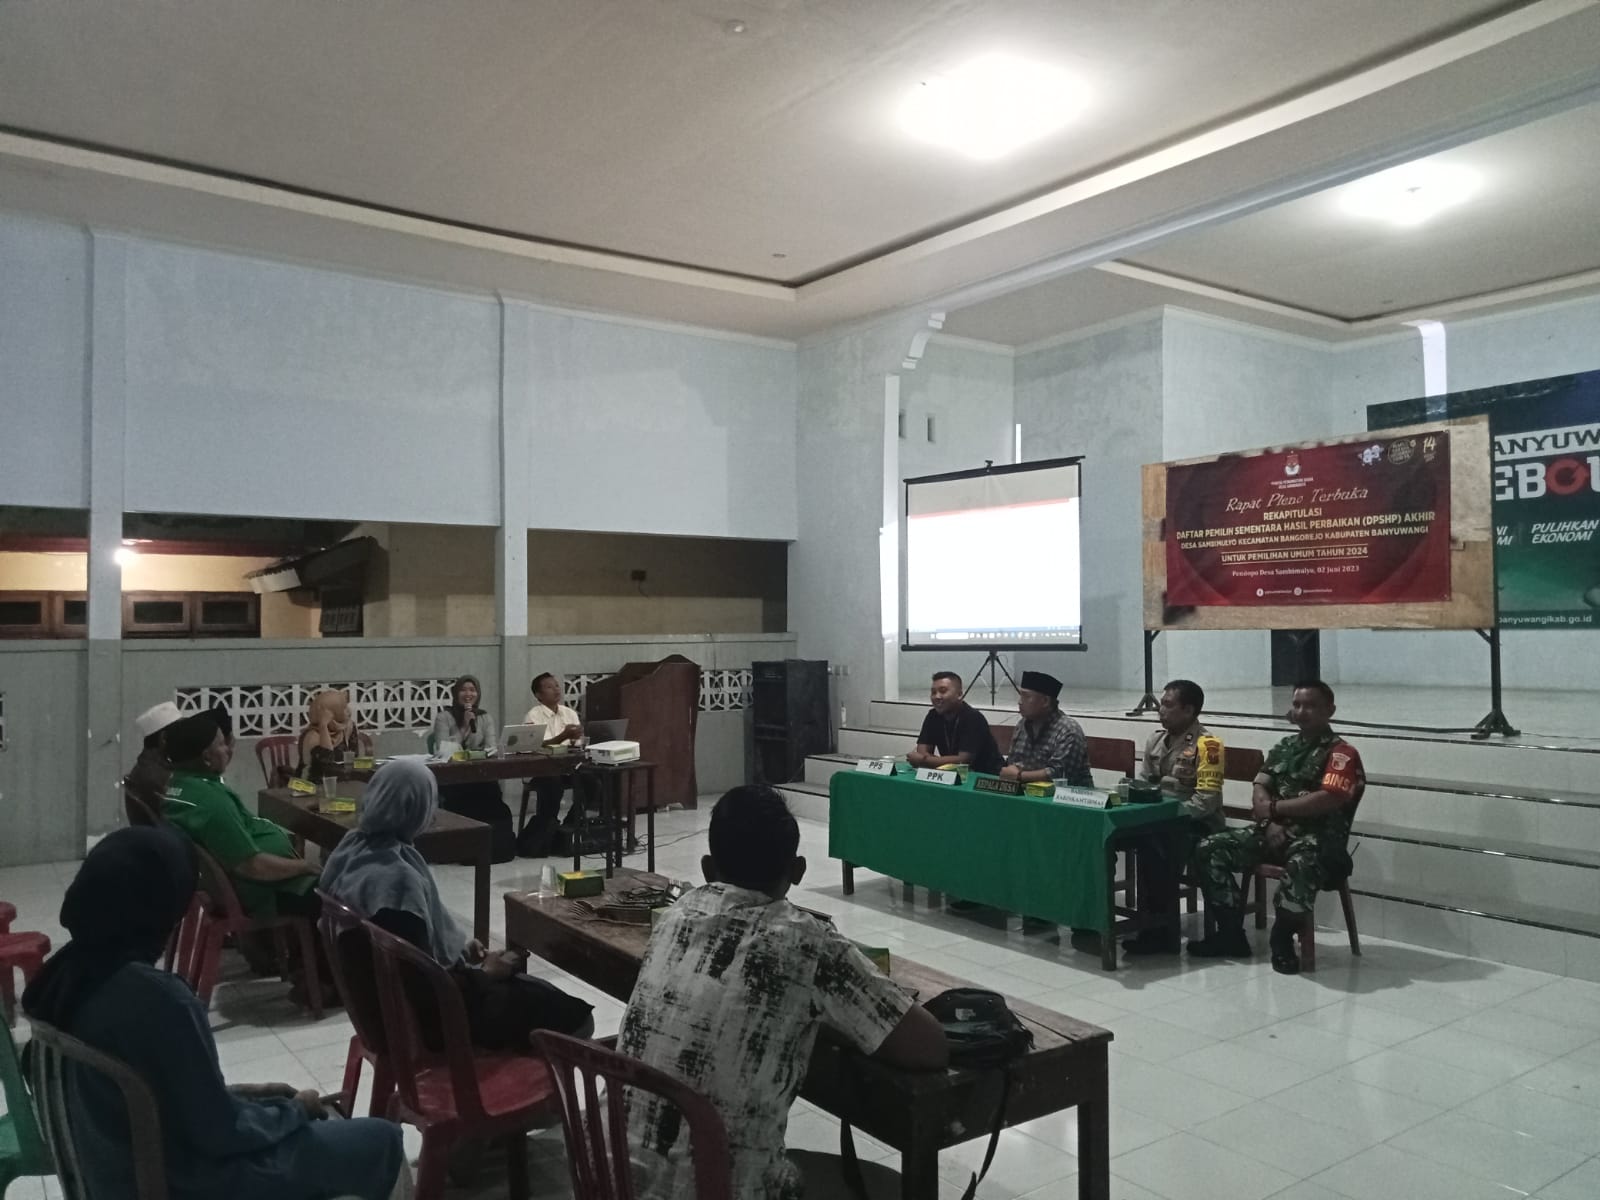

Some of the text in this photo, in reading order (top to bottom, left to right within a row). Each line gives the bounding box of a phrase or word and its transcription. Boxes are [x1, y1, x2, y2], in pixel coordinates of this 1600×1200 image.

[1225, 487, 1369, 514] Rapat Pleno Terbuka
[1263, 507, 1322, 521] REKAPITULASI
[1176, 511, 1436, 540] DAFTAR PEMILIH SEMENTARA HASIL PERBAIKAN (DPSHP) AKHIR
[1531, 520, 1600, 534] PULIHKAN
[1181, 525, 1429, 550] DESA SAMBIMULYO KECAMATAN BANGOREJO KABUPATEN BANYUWANGI
[1532, 531, 1594, 544] EKONOMI
[1221, 546, 1368, 562] UNTUK PEMILIHAN UMUM TAHUN 2024
[1259, 568, 1275, 576] Desa
[1316, 566, 1325, 574] 02
[1341, 564, 1360, 573] 2023
[868, 761, 883, 770] PPS
[926, 771, 945, 782] PPK
